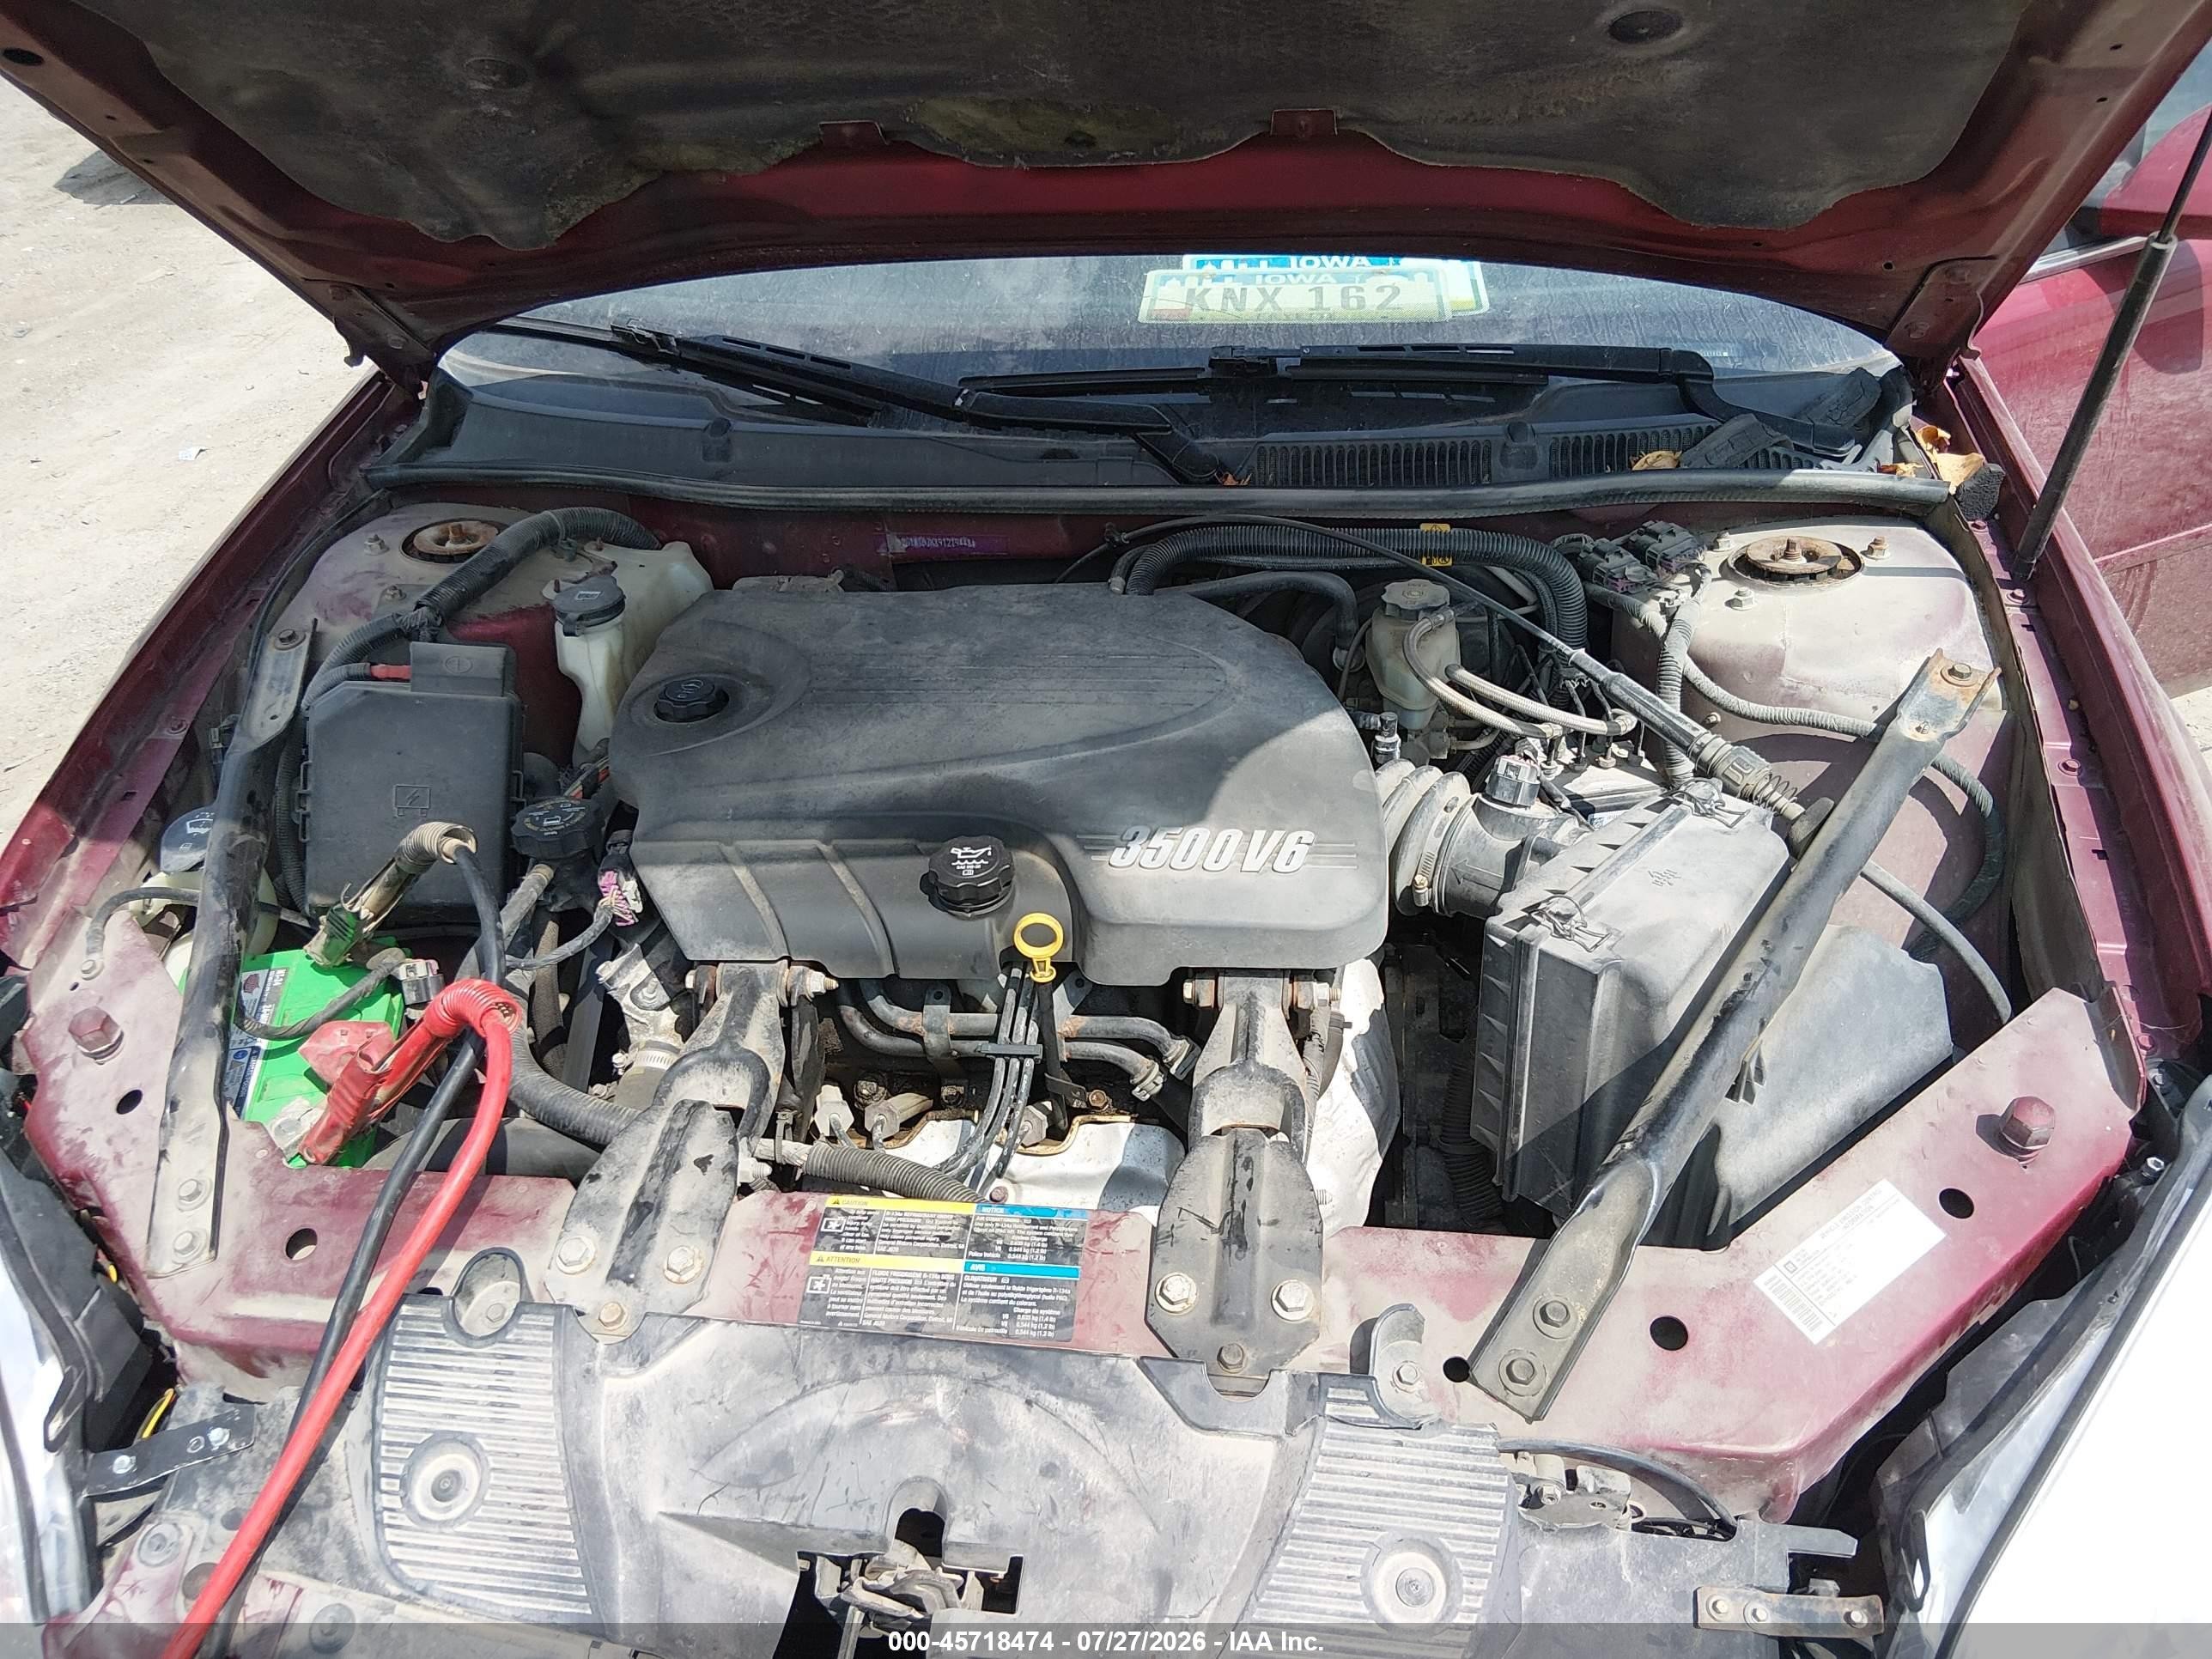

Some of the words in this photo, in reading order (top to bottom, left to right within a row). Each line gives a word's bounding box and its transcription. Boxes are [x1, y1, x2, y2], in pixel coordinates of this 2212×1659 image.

[1289, 255, 1372, 269] IOWA
[1255, 273, 1334, 284] IOWA
[1185, 285, 1281, 311] KNX
[1308, 285, 1402, 311] 162
[826, 1255, 860, 1263] ATTENTION
